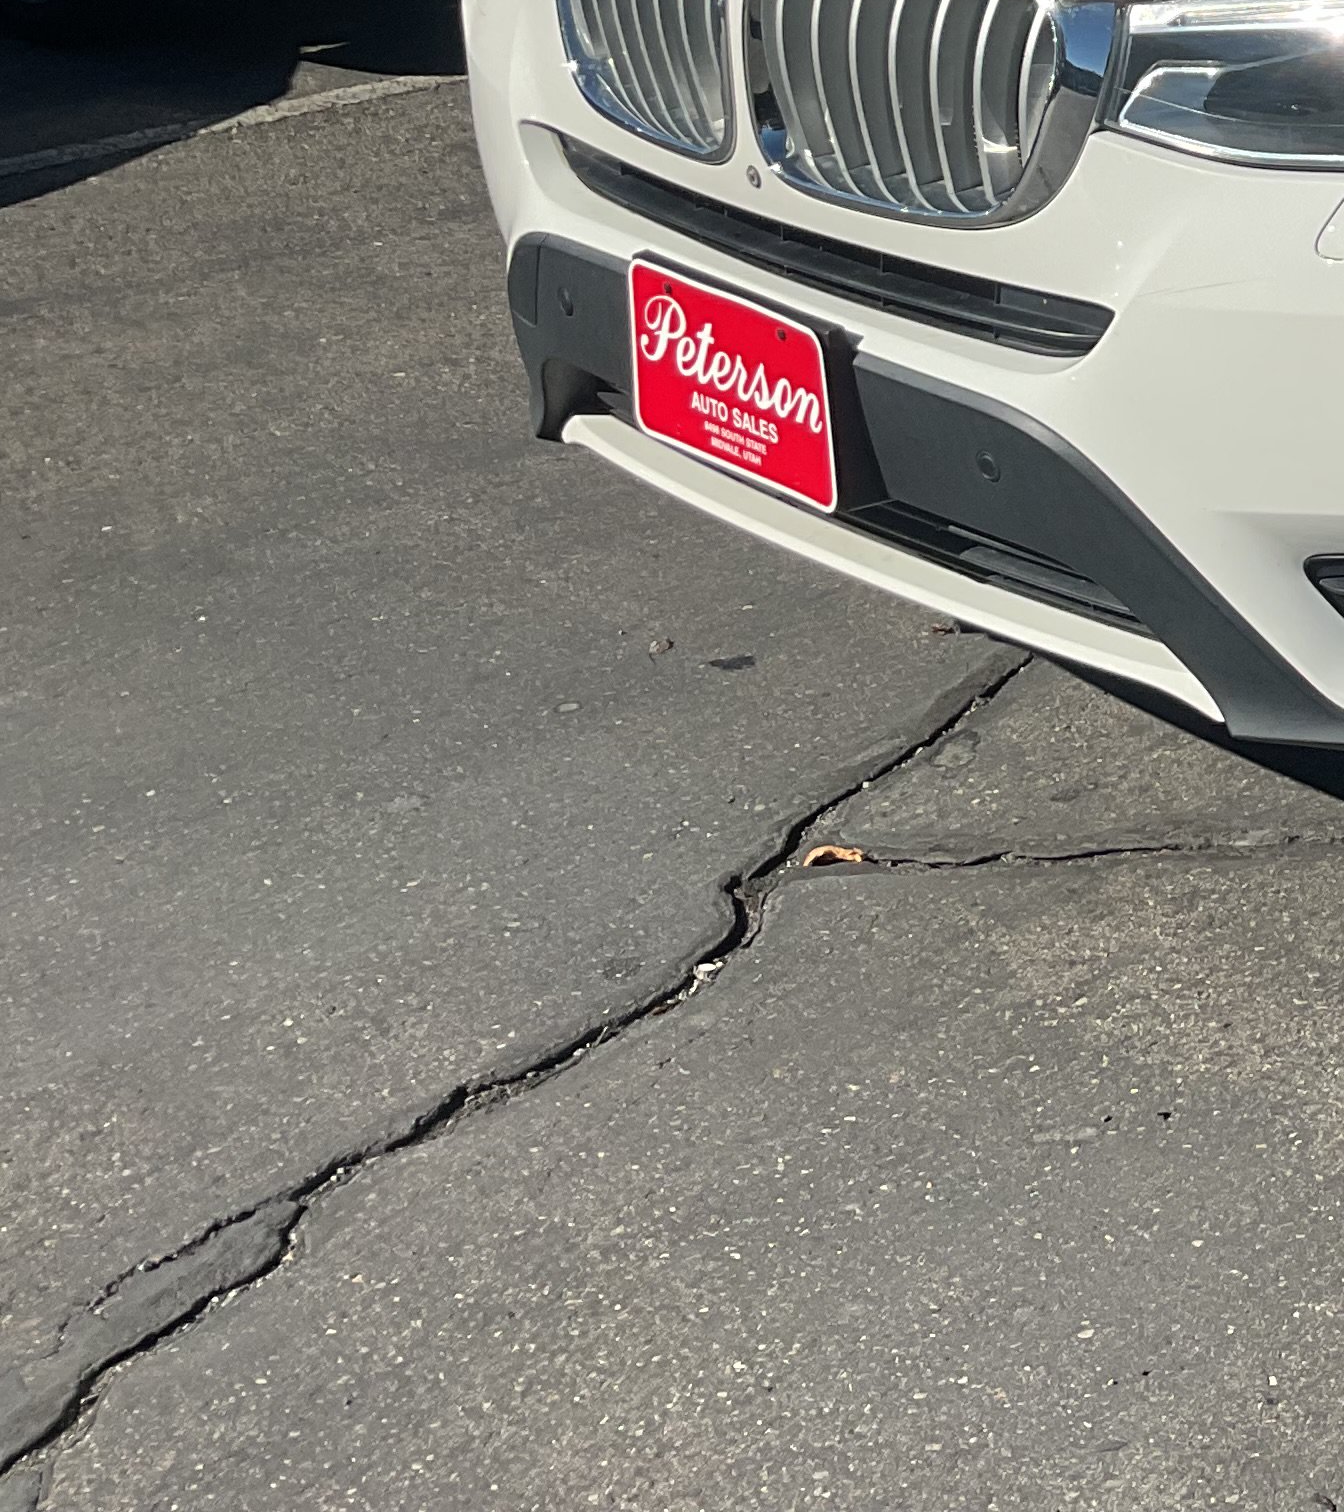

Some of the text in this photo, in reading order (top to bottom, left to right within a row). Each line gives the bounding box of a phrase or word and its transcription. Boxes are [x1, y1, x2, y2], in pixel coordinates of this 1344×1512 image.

[640, 295, 823, 434] Peterson
[691, 391, 779, 444] AUTO SALES
[720, 426, 745, 446] SOUTH
[745, 437, 767, 456] STATE
[742, 449, 762, 467] UTAH
